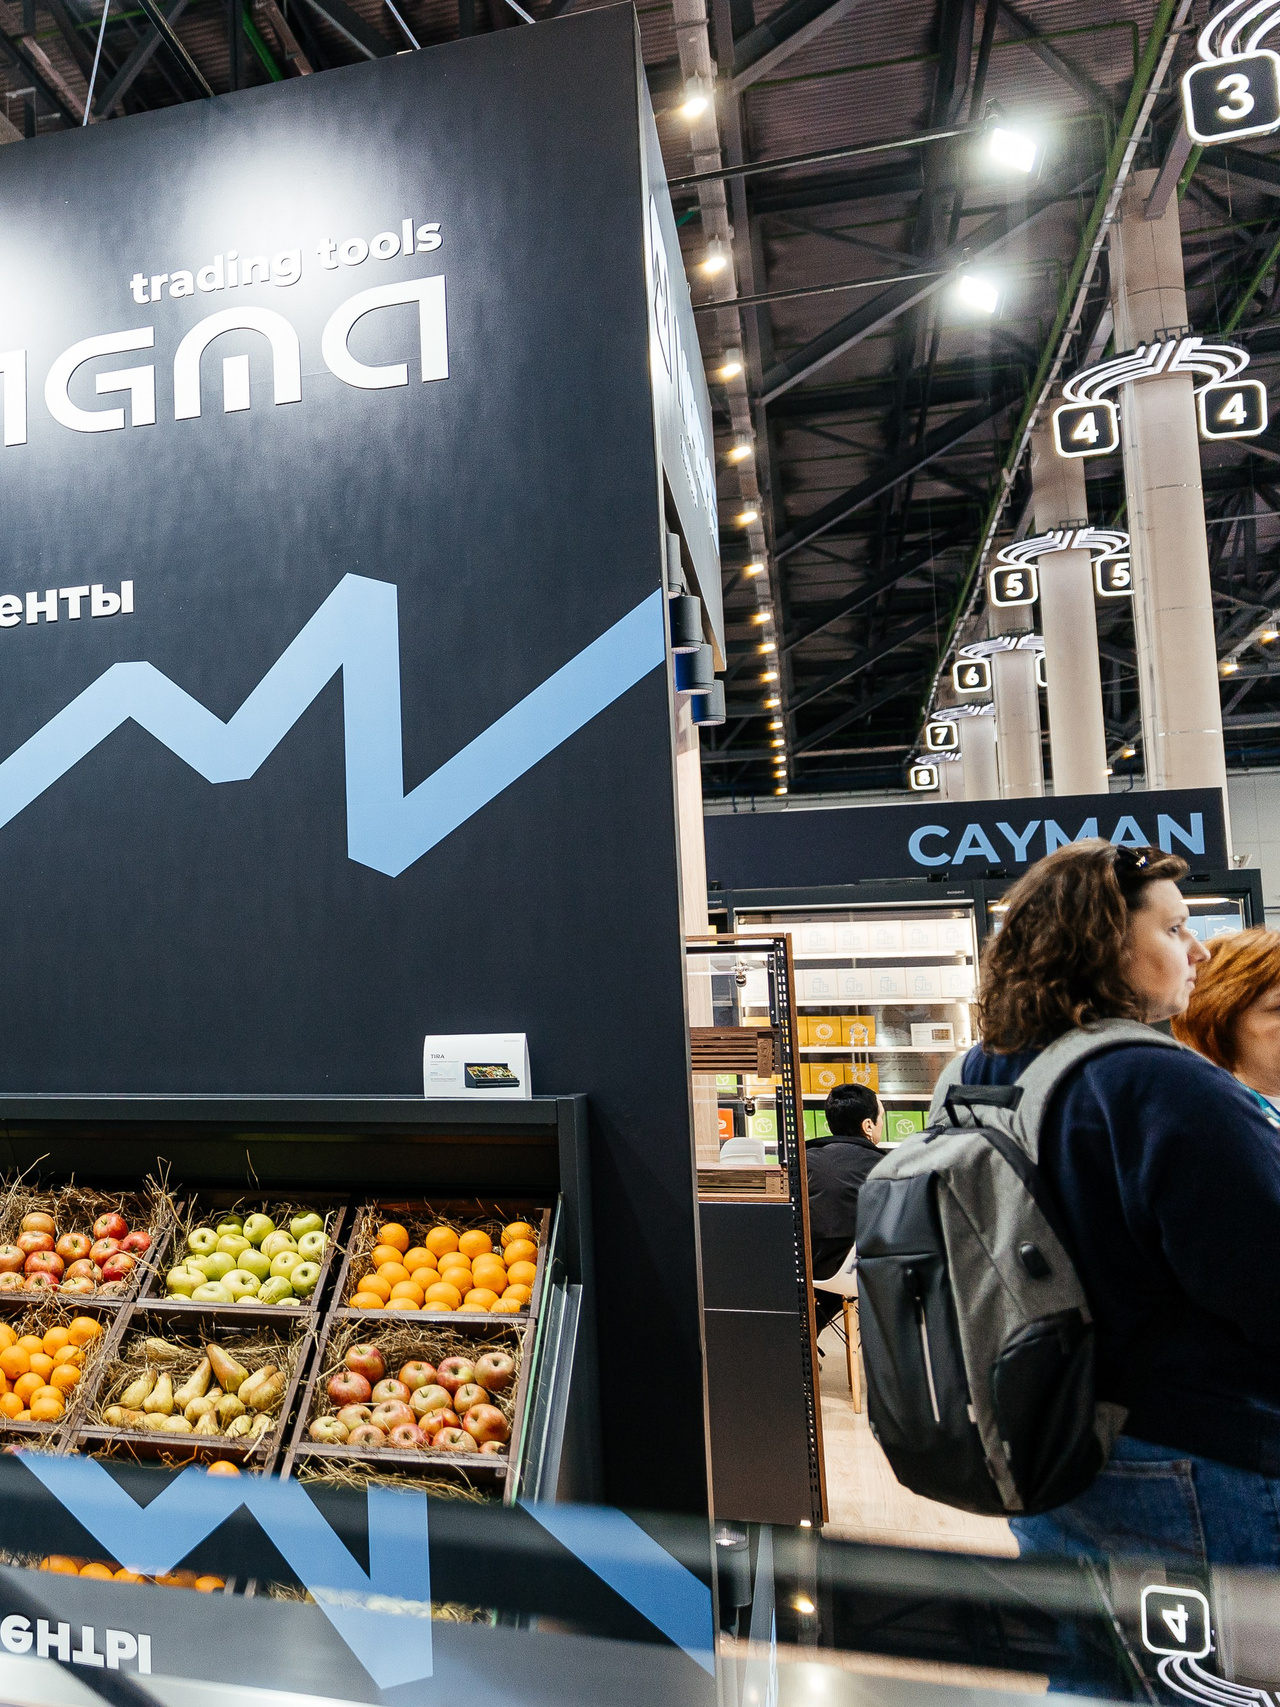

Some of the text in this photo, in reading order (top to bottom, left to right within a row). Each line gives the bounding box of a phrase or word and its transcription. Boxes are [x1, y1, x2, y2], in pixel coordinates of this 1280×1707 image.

[1216, 73, 1255, 120] 3
[129, 218, 444, 305] trading tools
[1220, 393, 1247, 425] 4
[1073, 412, 1099, 444] 4
[1005, 573, 1023, 596] 5
[1112, 562, 1130, 586] 5
[965, 666, 980, 686] 6
[934, 727, 948, 745] 7
[918, 769, 930, 785] 8
[908, 812, 1205, 866] CAYMAN
